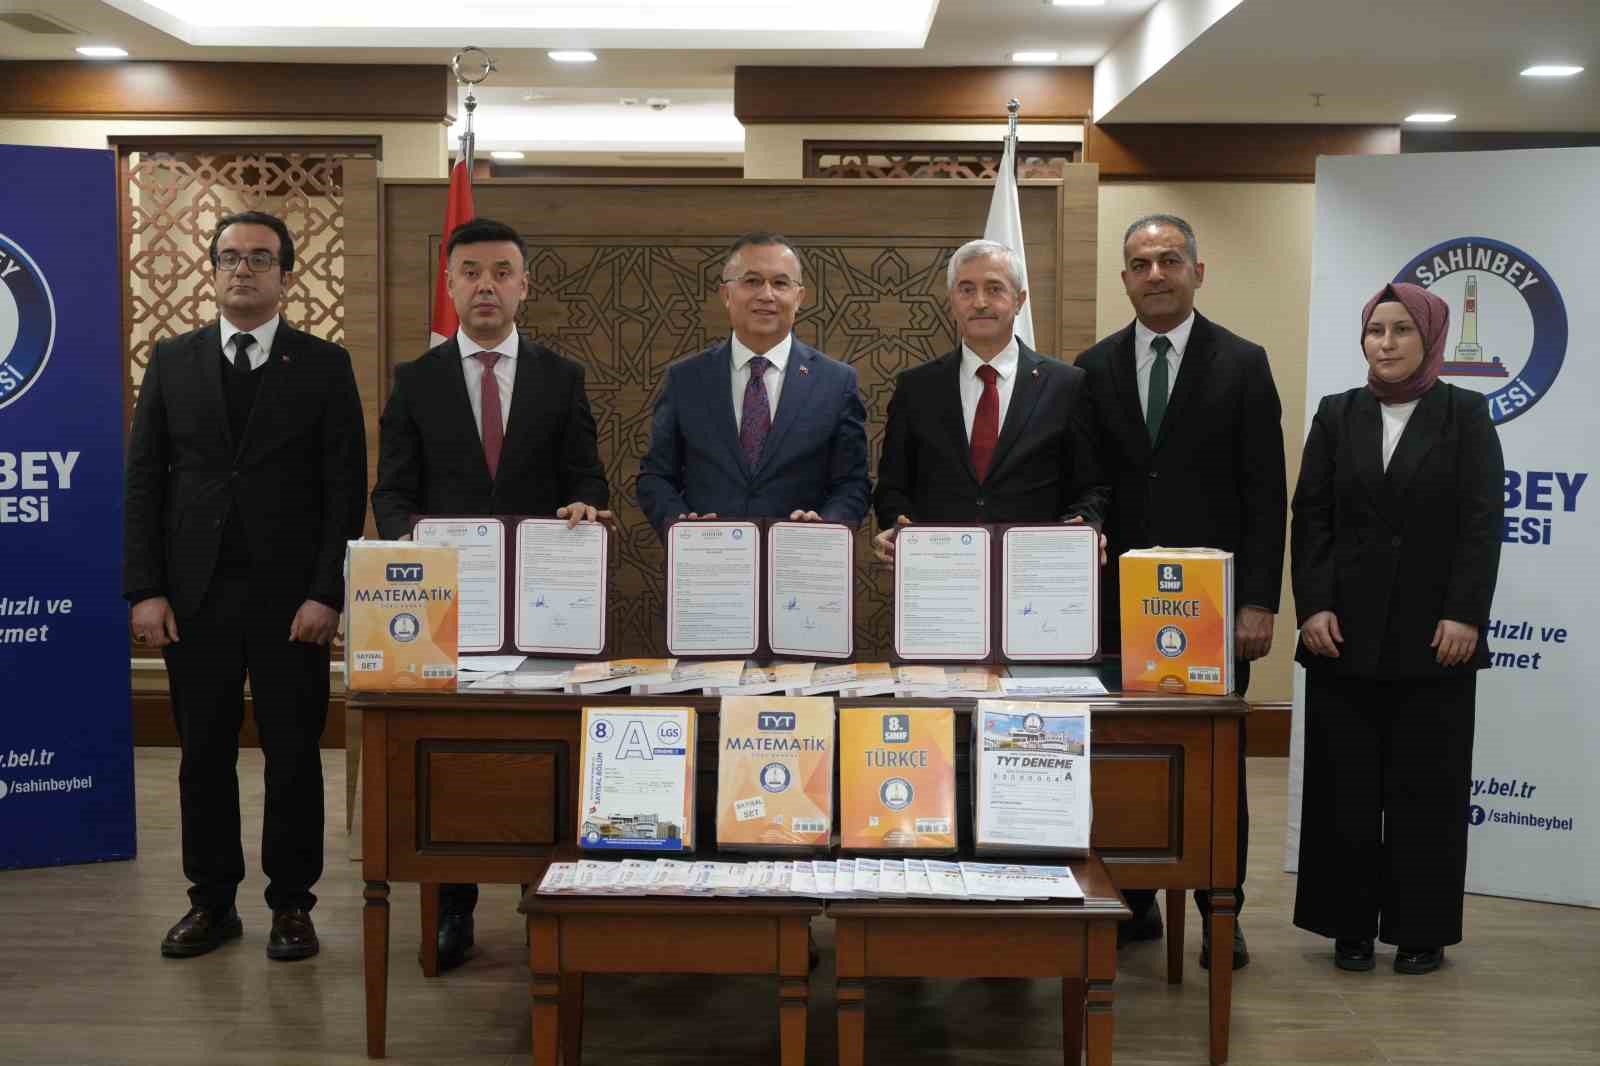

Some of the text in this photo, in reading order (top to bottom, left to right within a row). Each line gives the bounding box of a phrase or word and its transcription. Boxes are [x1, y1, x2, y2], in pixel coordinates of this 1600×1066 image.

[389, 567, 421, 578] TYT
[1163, 566, 1177, 580] 8.
[355, 586, 452, 601] MATEMATİK
[47, 599, 73, 615] ve
[1142, 597, 1200, 618] TÜRKÇE
[1541, 627, 1568, 643] ve
[761, 716, 794, 727] TYT
[888, 717, 903, 730] 8.
[595, 722, 607, 738] 8
[660, 728, 679, 738] LGS
[615, 720, 654, 760] A
[726, 736, 825, 751] MATEMATİK
[865, 748, 928, 768] TÜRKÇE
[997, 756, 1073, 769] TYT DENEME
[1471, 777, 1537, 799] y.bel.tr
